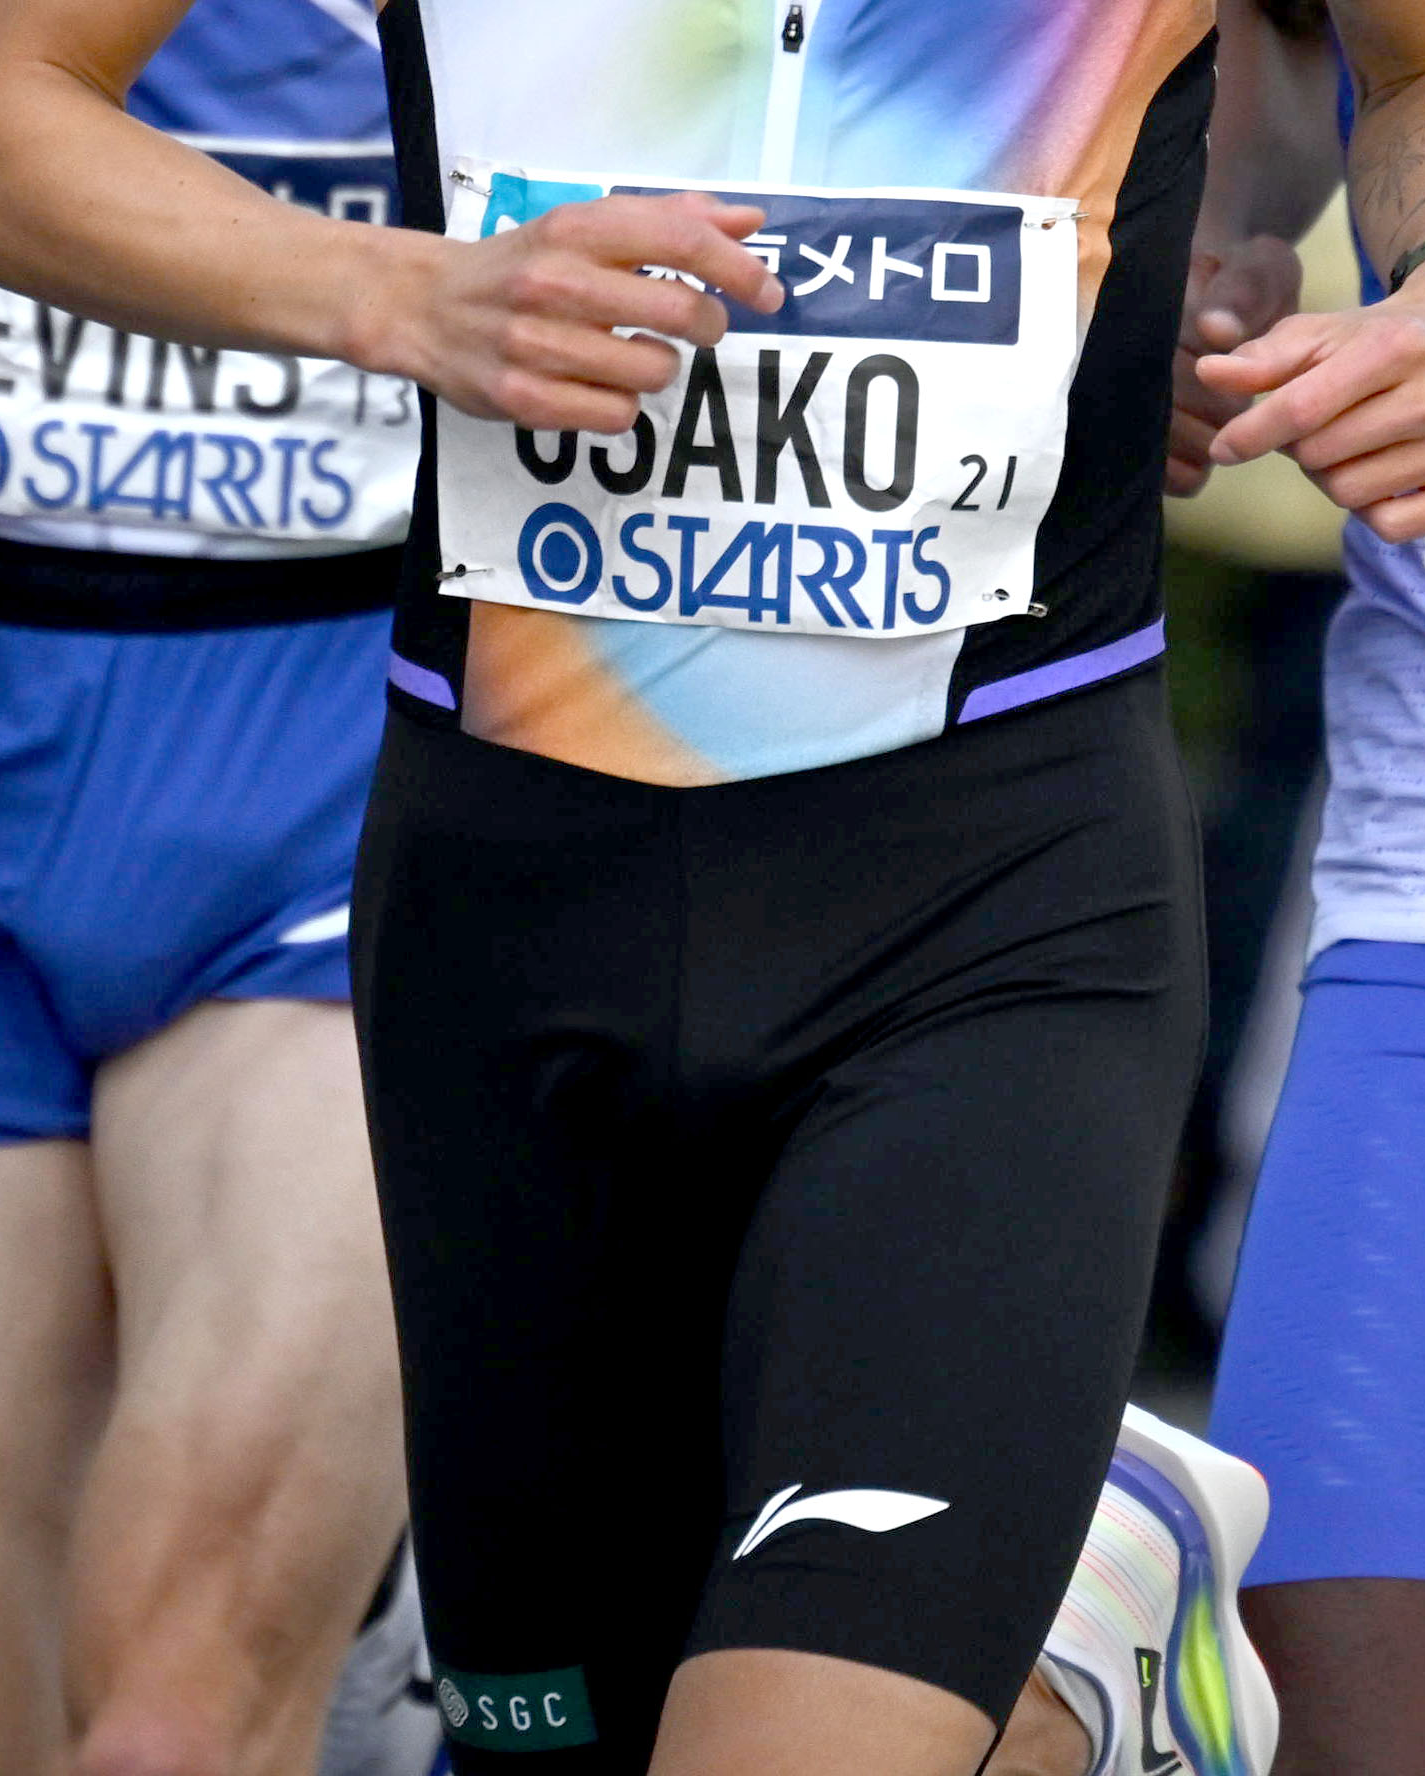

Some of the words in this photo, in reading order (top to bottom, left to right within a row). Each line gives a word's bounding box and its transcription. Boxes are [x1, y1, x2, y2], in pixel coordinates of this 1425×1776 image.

[639, 233, 991, 303] メトロ
[950, 453, 1018, 512] 21
[478, 1692, 567, 1731] SGC
